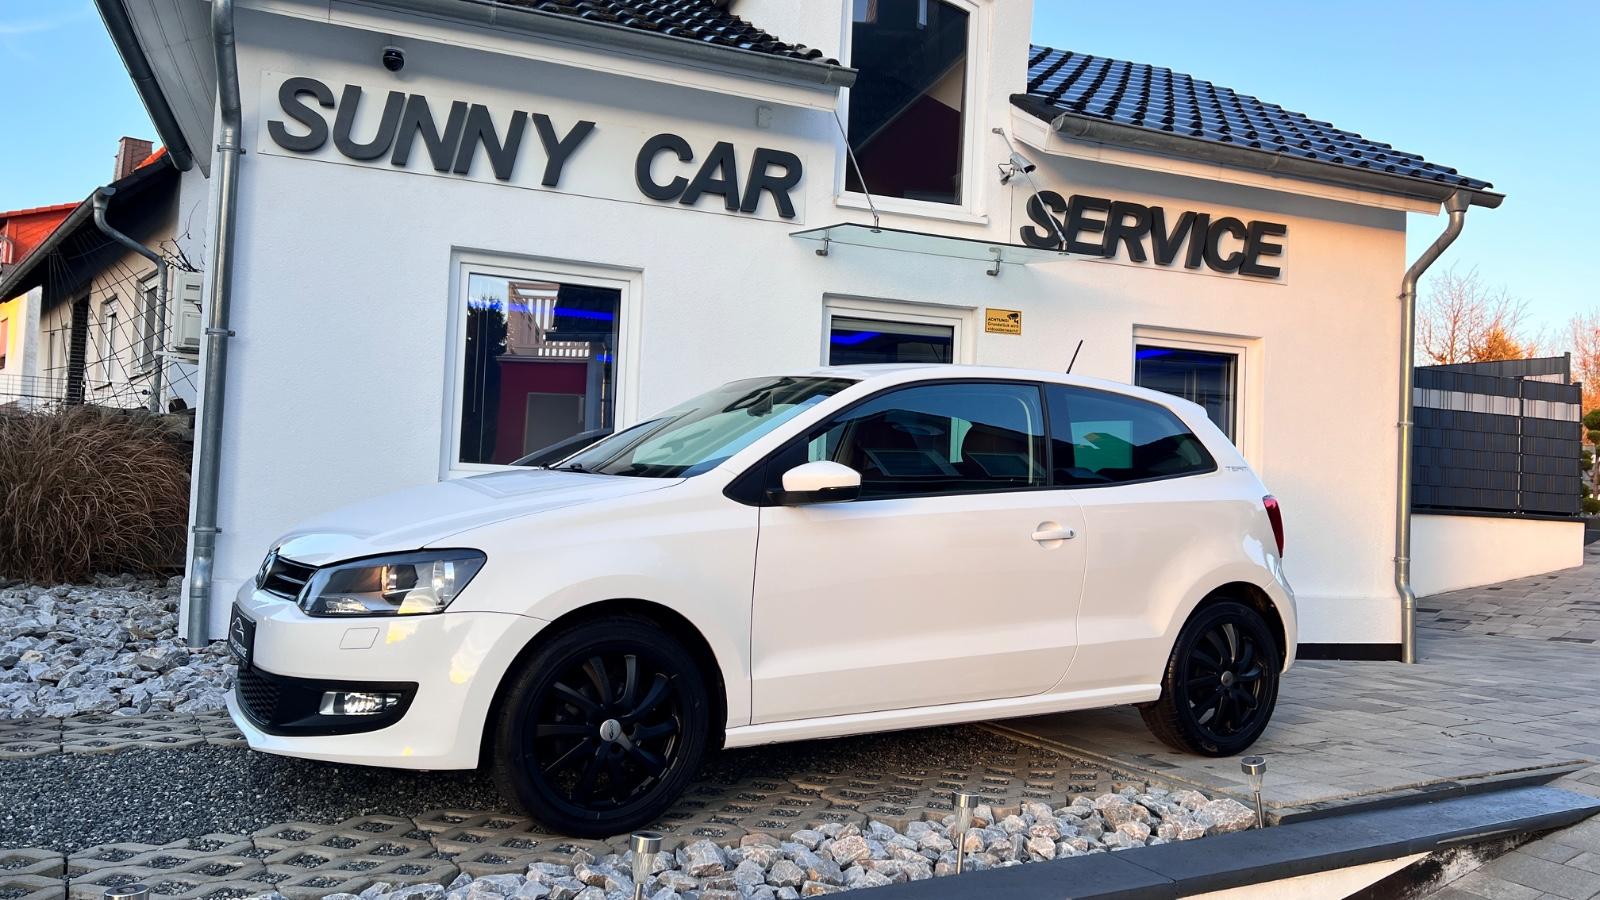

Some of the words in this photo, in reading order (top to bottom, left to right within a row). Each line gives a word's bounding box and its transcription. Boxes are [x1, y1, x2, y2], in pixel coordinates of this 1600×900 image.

[267, 76, 595, 186] SUNNY
[634, 133, 802, 218] CAR
[1020, 190, 1287, 278] SERVICE
